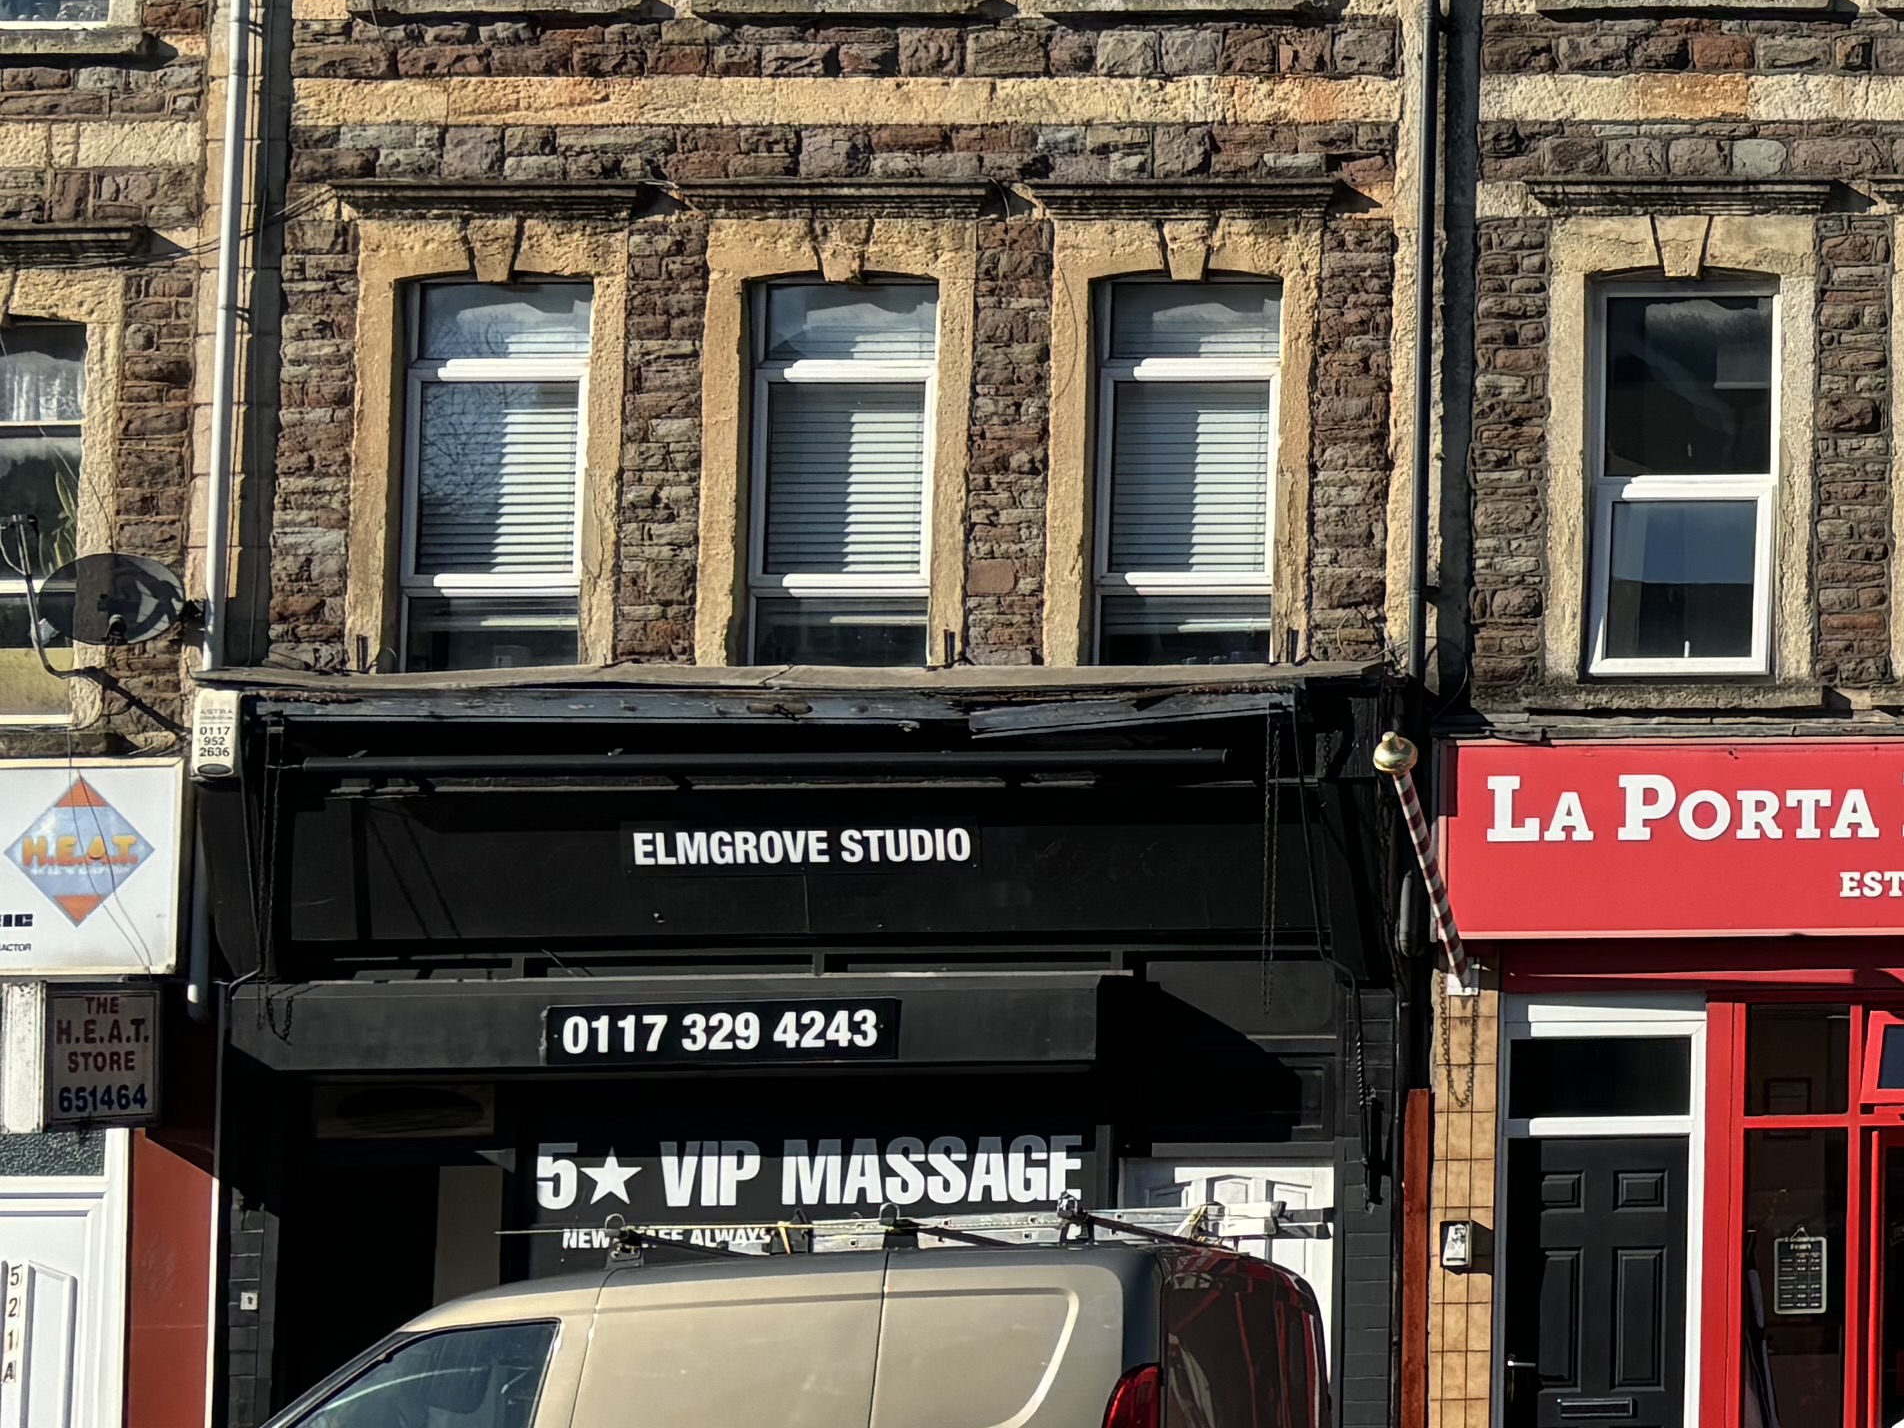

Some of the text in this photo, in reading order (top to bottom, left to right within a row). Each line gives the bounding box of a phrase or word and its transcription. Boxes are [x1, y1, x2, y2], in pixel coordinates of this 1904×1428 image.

[199, 726, 231, 735] 0117
[203, 736, 226, 745] 952
[1487, 775, 1594, 842] LA
[1617, 773, 1880, 841] PORTA
[633, 827, 971, 866] ELMGROVE STUDIO
[85, 996, 120, 1014] THE
[56, 1018, 149, 1044] H.E.A.T.
[562, 1009, 879, 1056] 0117 329 4243
[68, 1051, 136, 1073] STORE
[58, 1083, 148, 1113] 651464
[537, 1134, 1082, 1210] 5 VIP MASSAGE
[562, 1228, 609, 1249] NEW
[690, 1226, 772, 1248] ALWAYS
